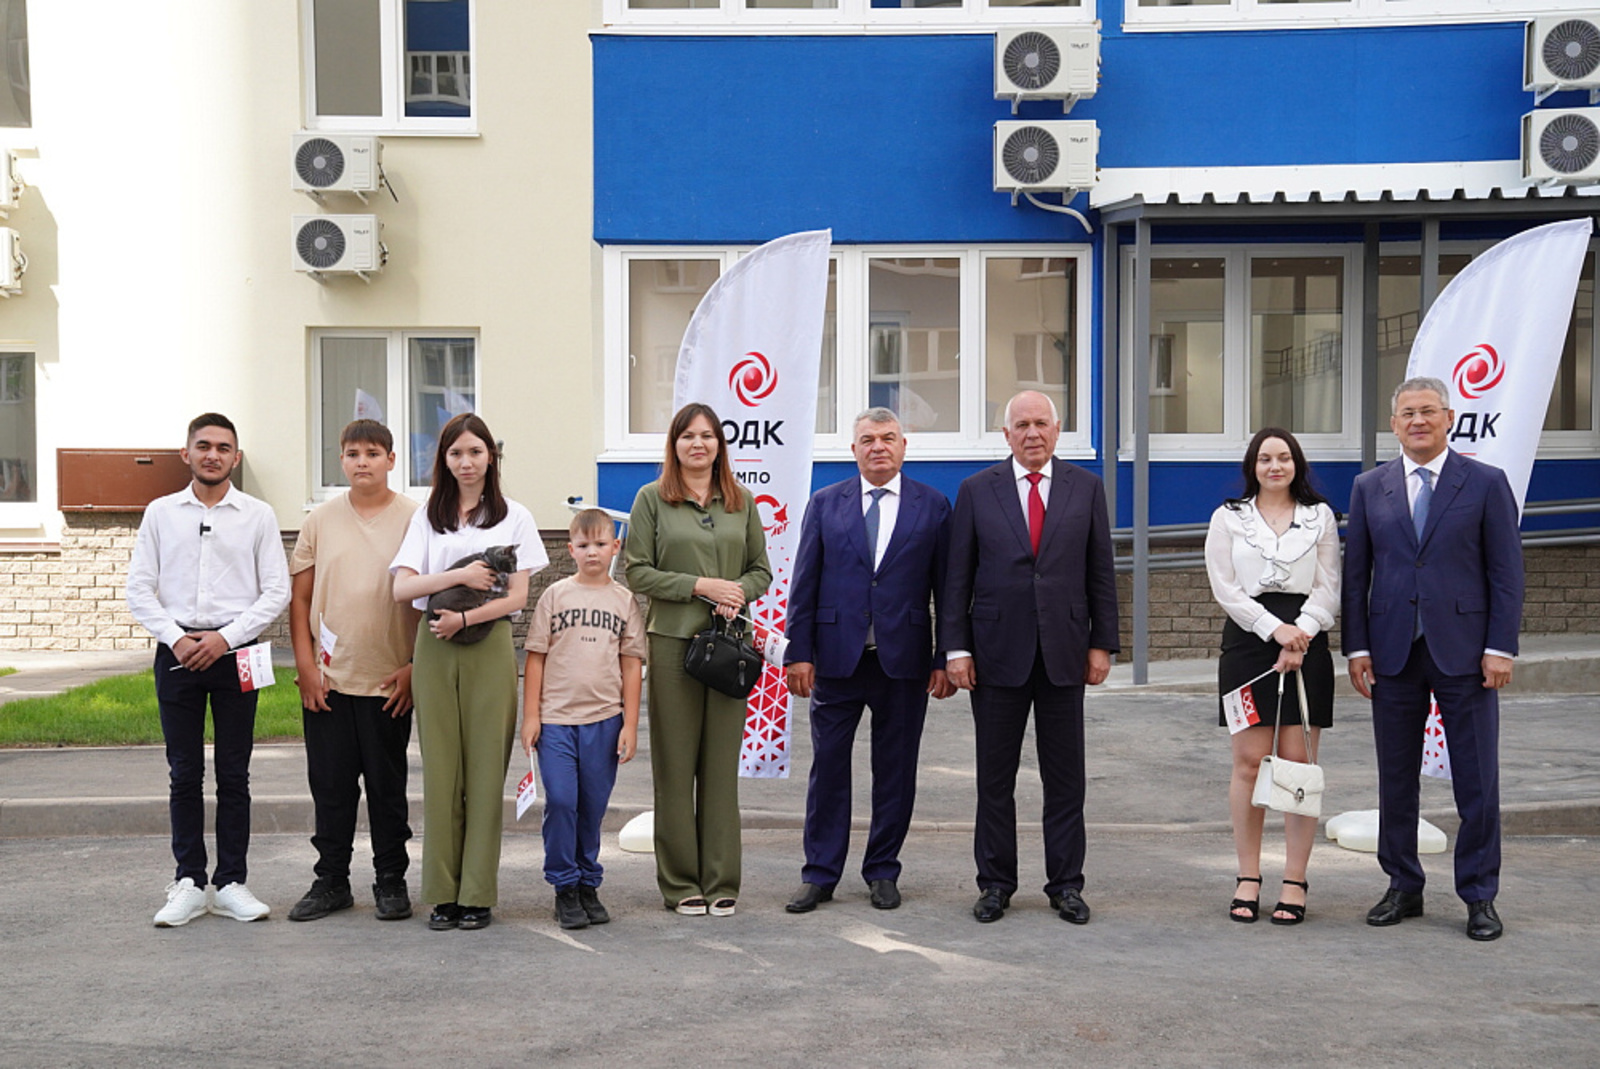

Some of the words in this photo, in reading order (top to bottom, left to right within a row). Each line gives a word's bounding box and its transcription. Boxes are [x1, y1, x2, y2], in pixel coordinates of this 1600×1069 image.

[720, 419, 784, 449] ОДК
[1446, 412, 1502, 442] ДК
[732, 471, 771, 484] МПО
